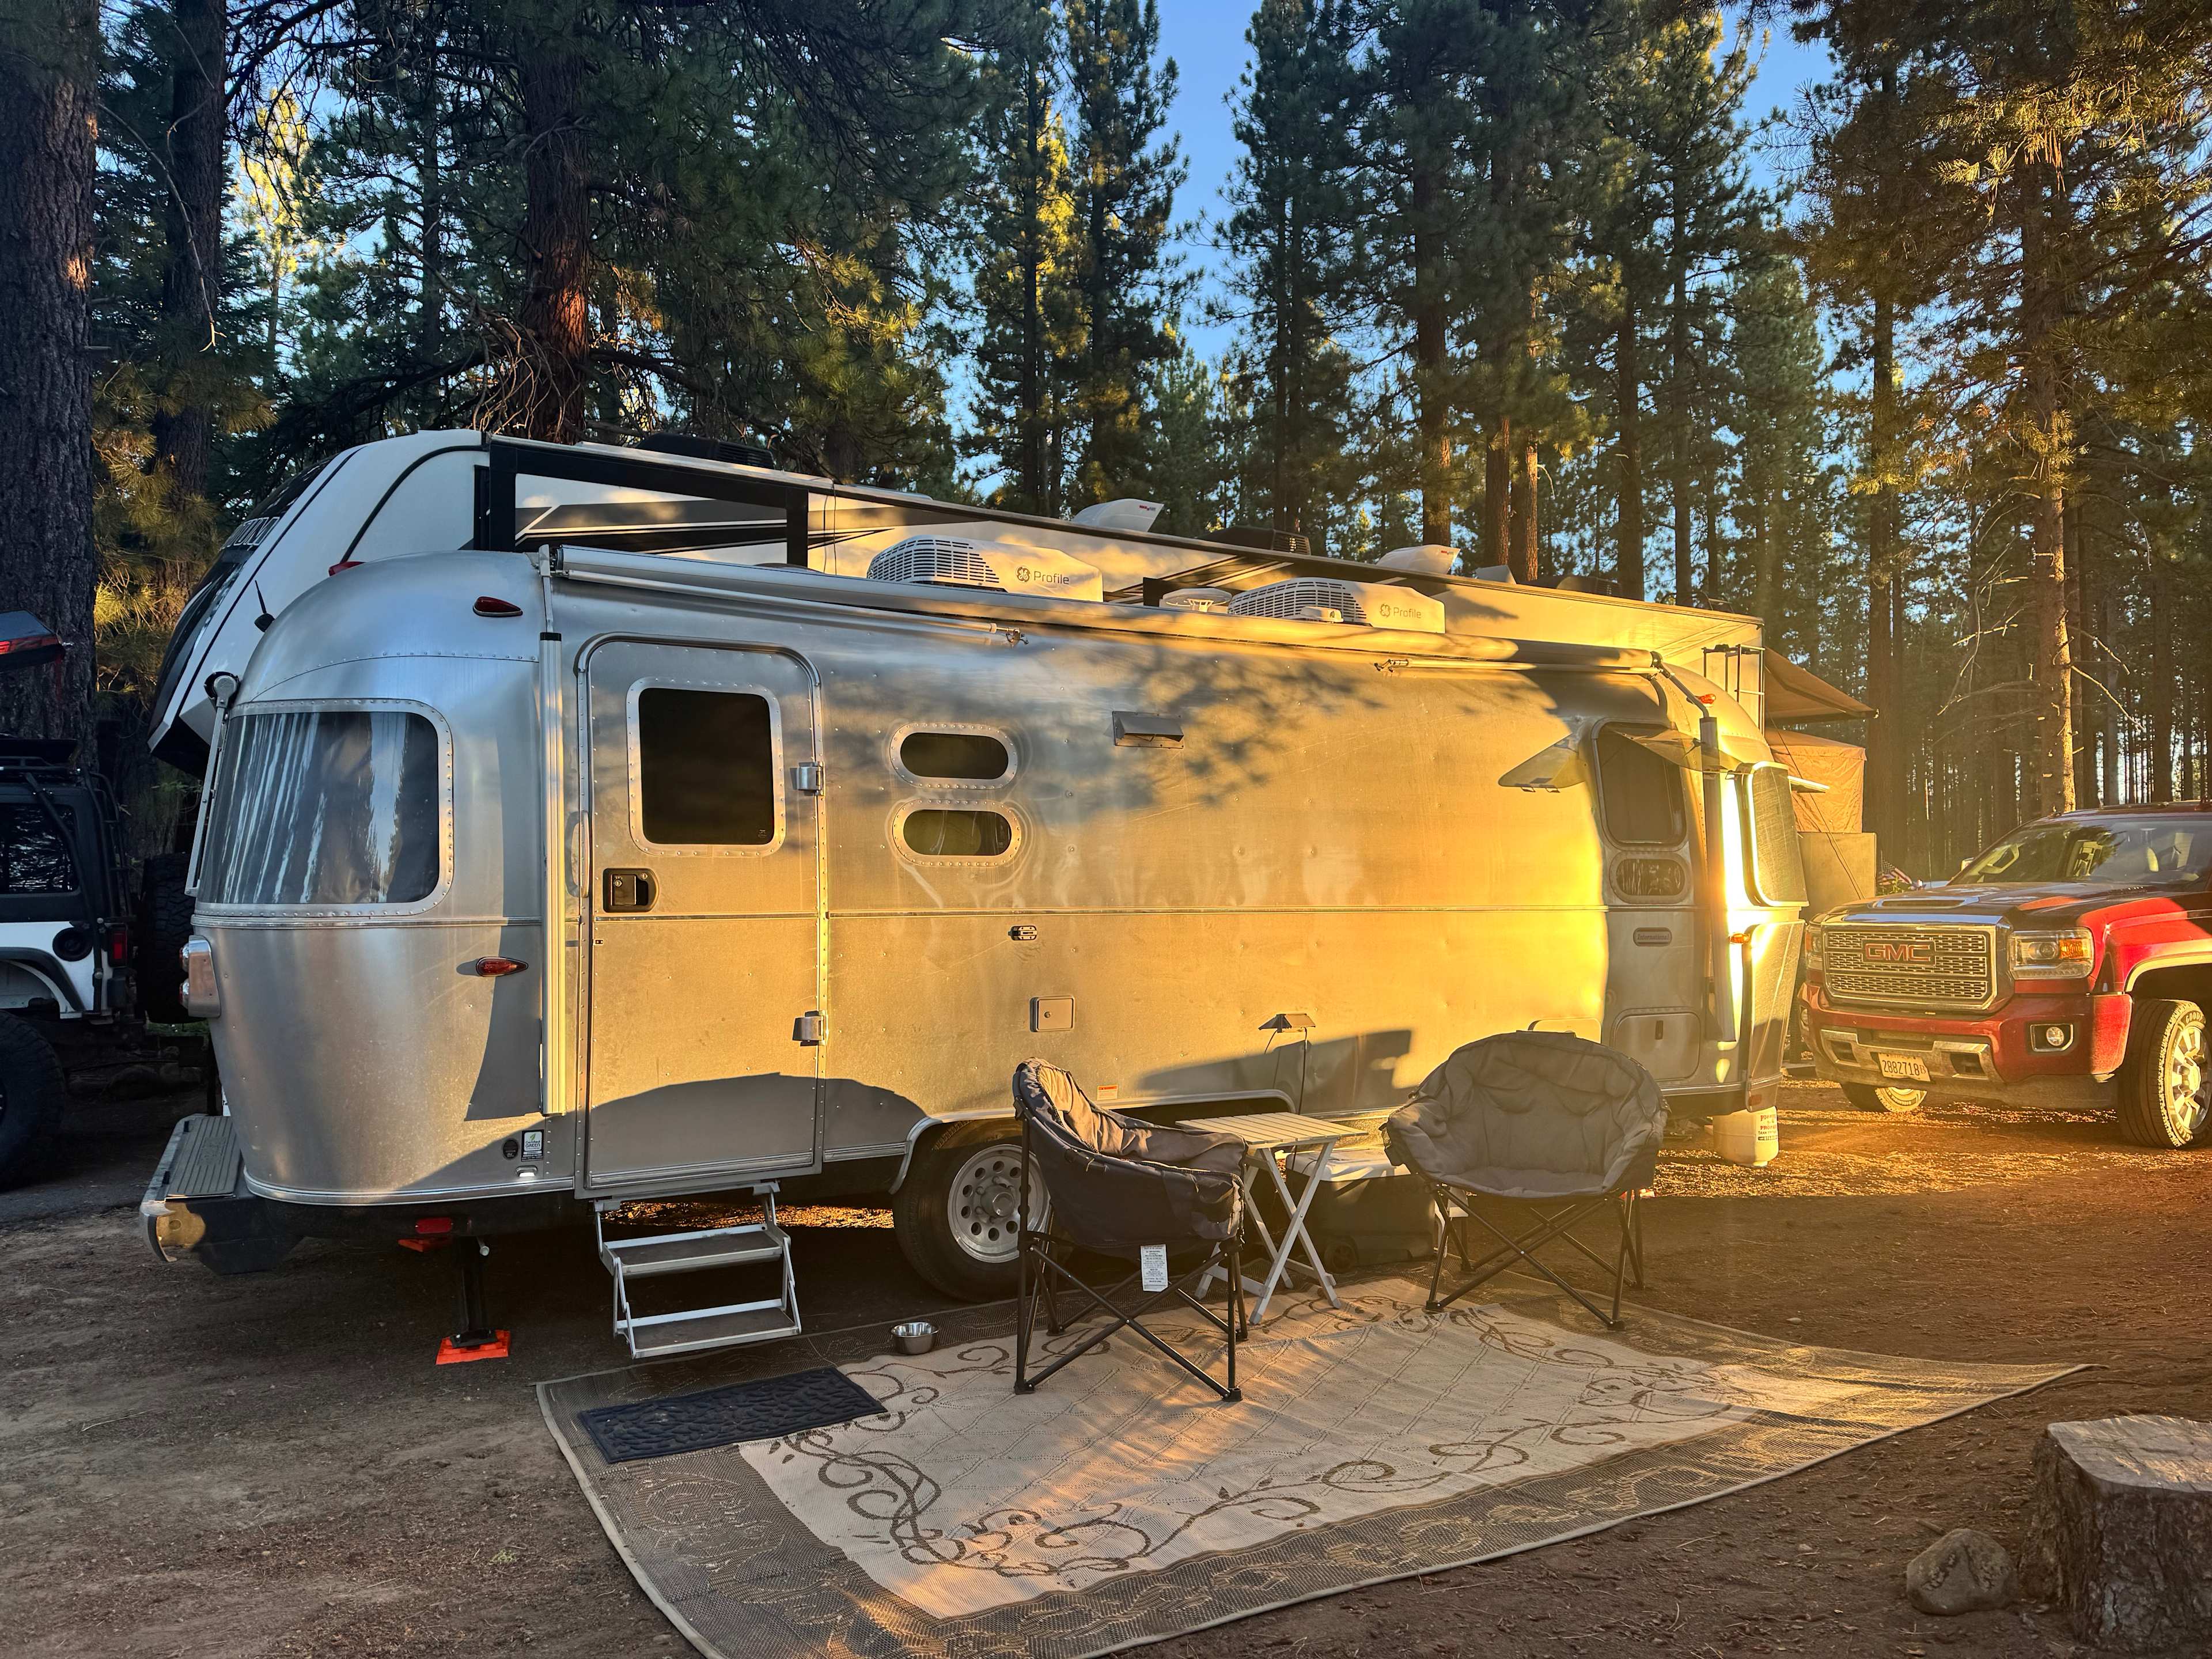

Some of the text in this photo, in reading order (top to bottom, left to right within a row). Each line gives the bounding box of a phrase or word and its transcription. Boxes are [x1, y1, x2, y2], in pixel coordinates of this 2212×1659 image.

[1034, 571, 1070, 585] Profile
[1393, 607, 1422, 619] Profile
[1865, 943, 1930, 962] GMC
